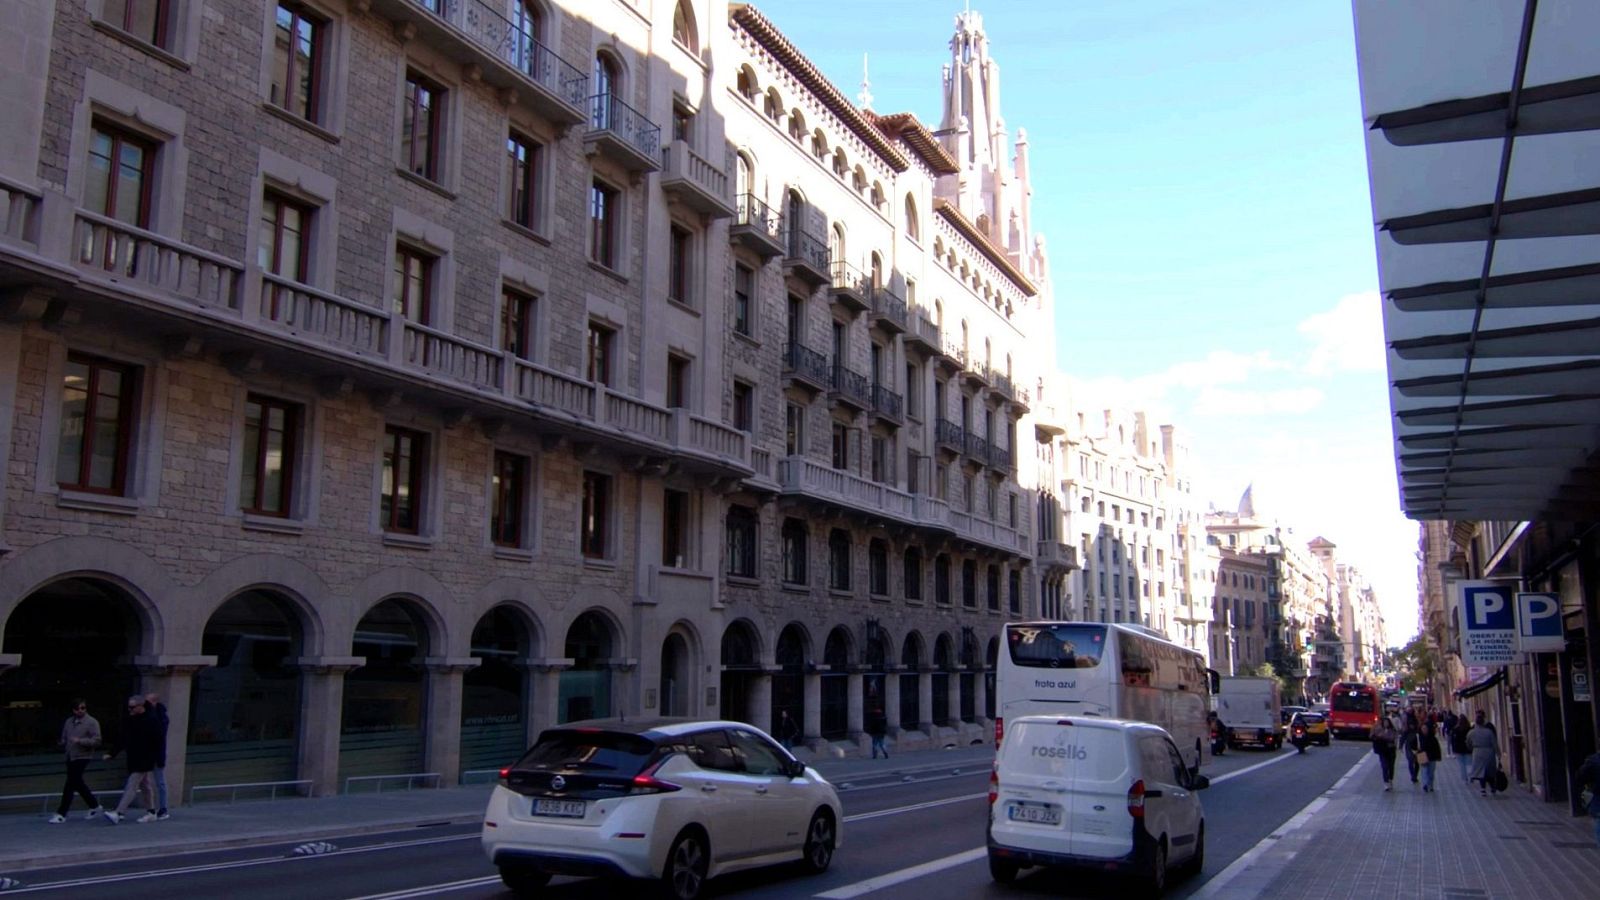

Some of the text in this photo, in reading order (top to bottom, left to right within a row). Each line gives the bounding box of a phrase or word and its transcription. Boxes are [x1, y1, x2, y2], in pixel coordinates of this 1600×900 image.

[1473, 592, 1504, 625] P
[1520, 595, 1558, 636] P
[1057, 680, 1076, 688] azul
